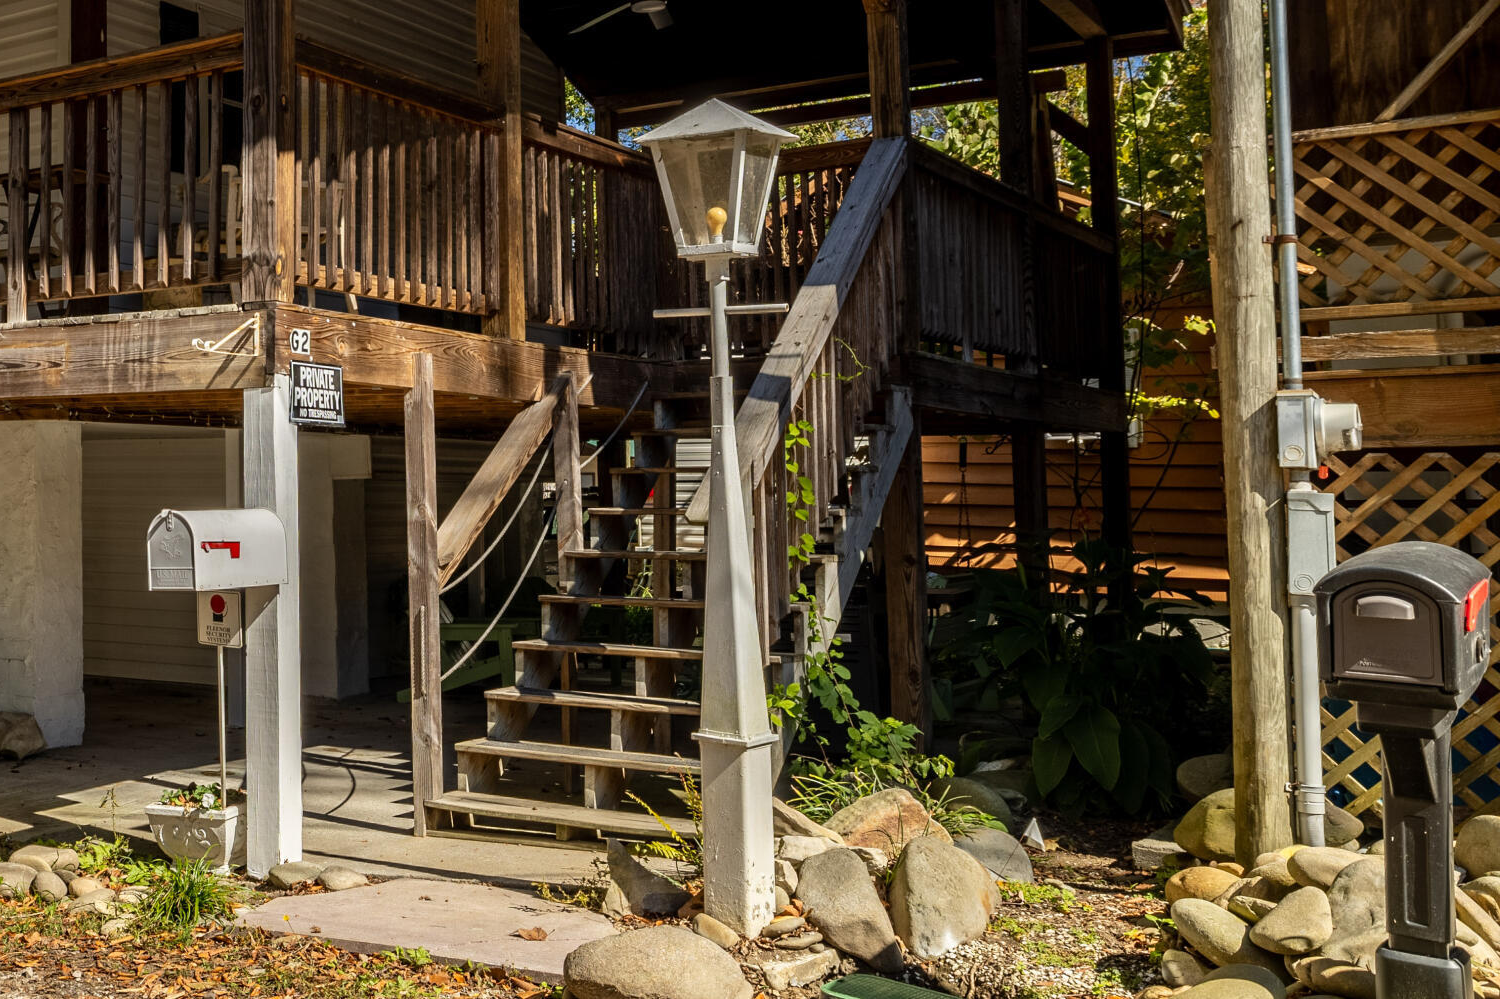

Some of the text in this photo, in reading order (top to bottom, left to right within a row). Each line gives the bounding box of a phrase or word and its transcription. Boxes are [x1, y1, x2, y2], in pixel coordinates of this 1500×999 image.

[299, 366, 335, 389] PRIVATE
[294, 387, 340, 410] PROPERTY
[299, 407, 337, 420] NO TRESPASSING
